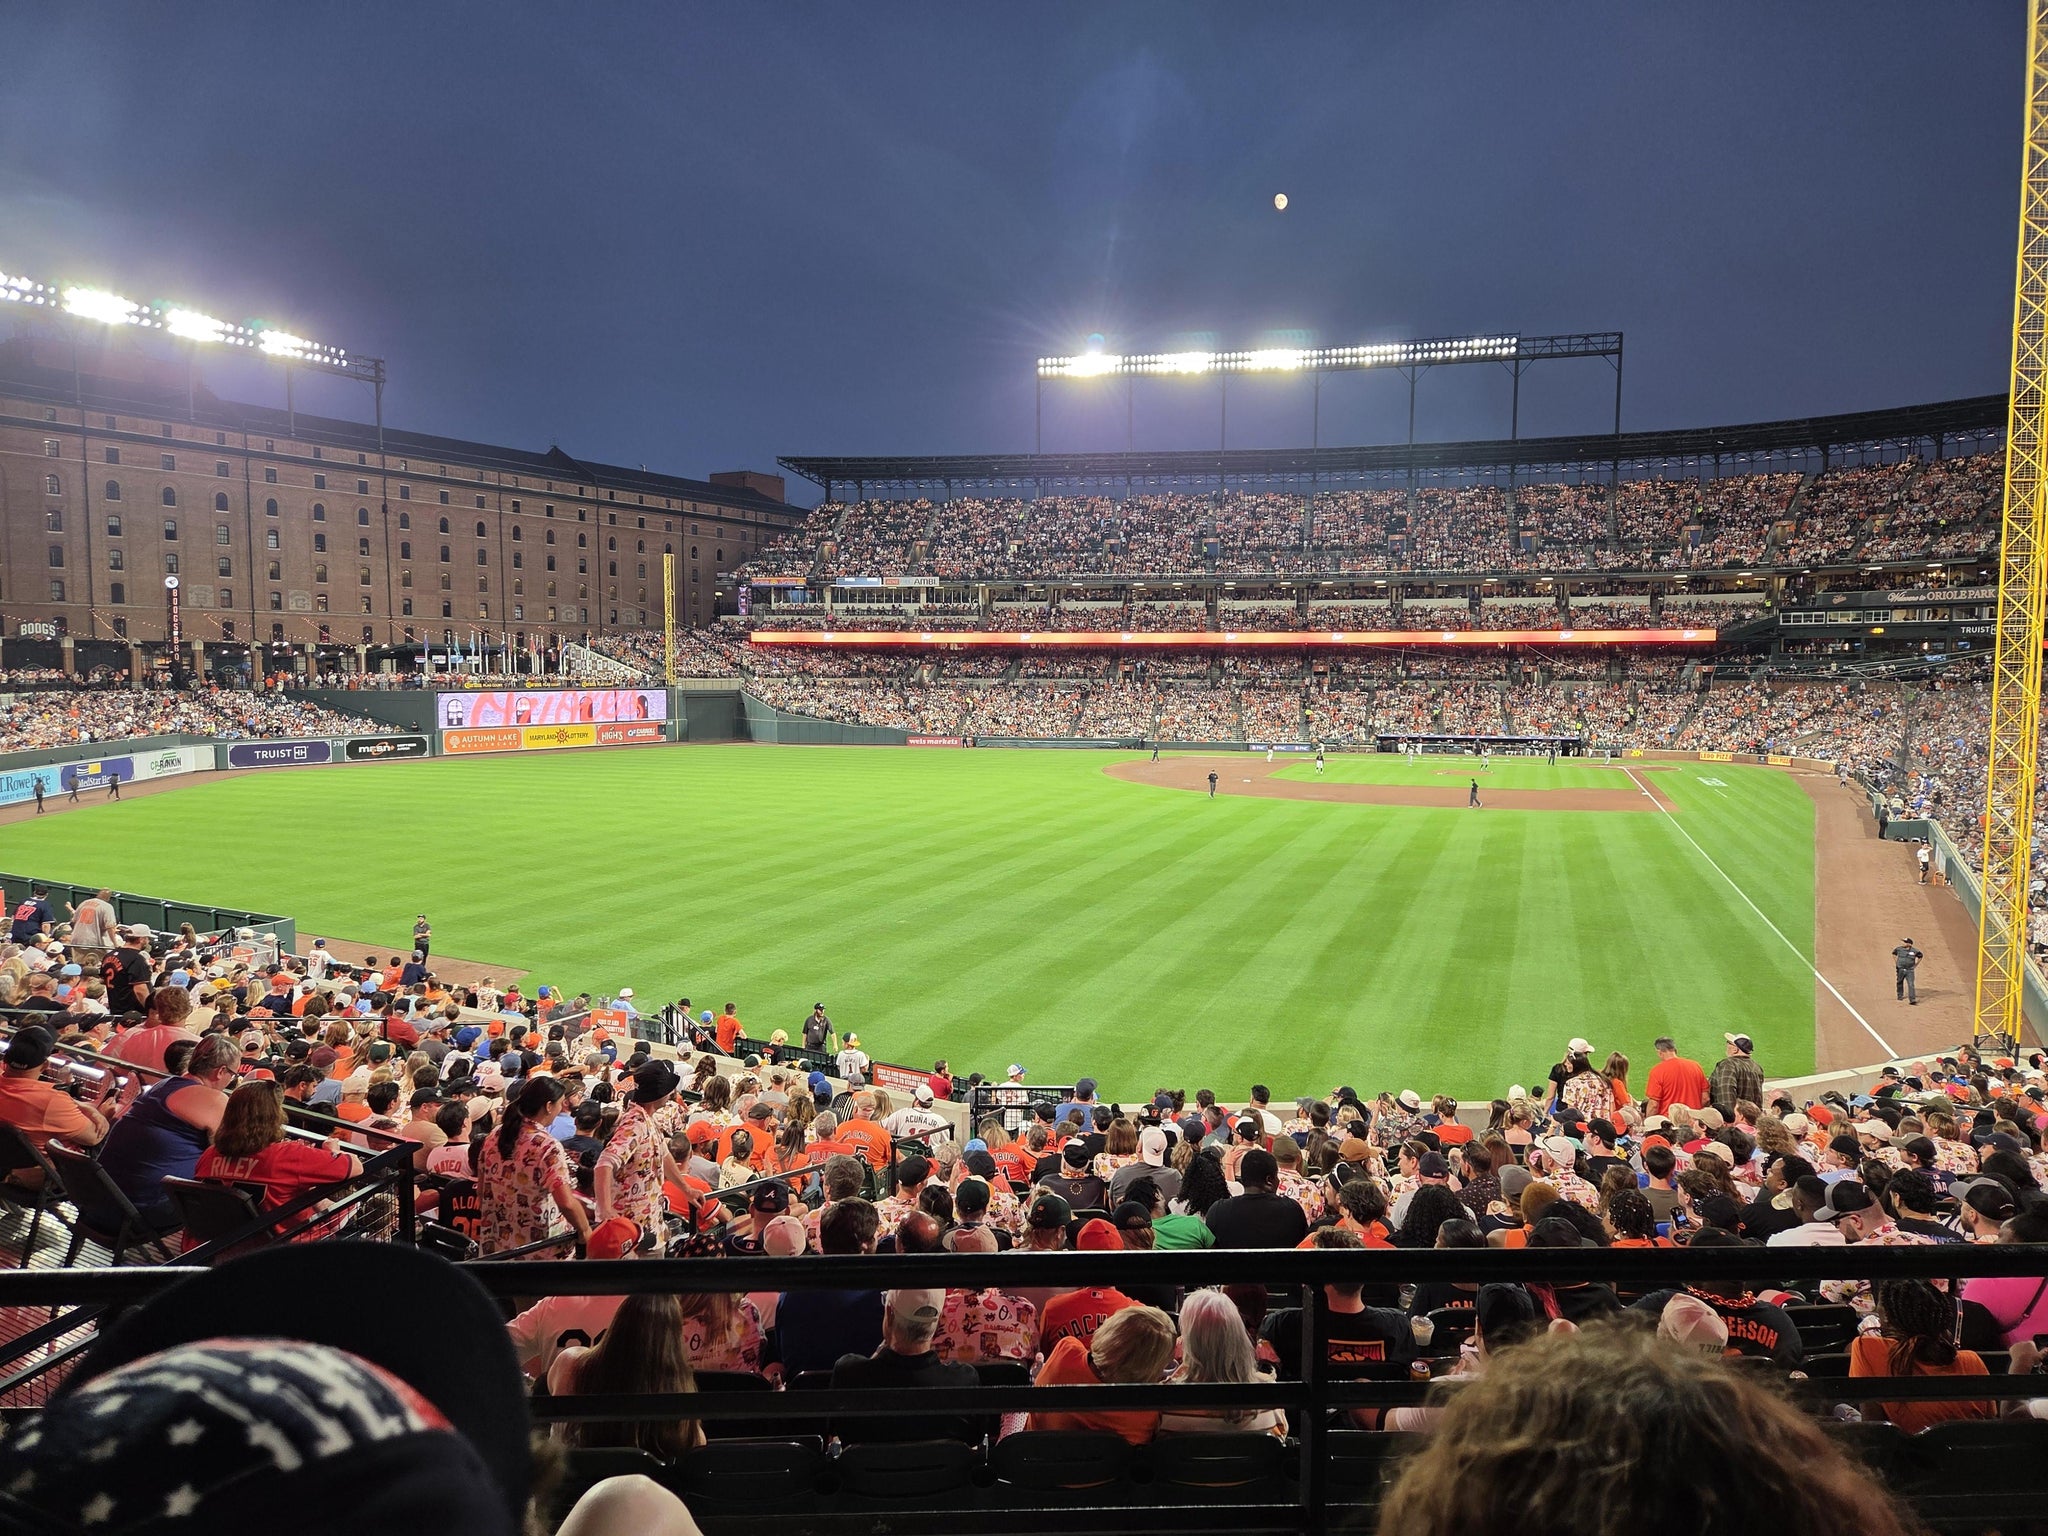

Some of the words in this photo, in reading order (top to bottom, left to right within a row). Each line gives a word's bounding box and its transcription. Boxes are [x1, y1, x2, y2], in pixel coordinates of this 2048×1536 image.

[1926, 590, 1967, 601] ORIOLE
[1968, 589, 1997, 599] PARK
[1961, 626, 1990, 634] TRUIST
[601, 731, 623, 741] HIGH'S
[254, 749, 292, 759] TRUIST
[31, 773, 51, 788] Pice
[15, 905, 37, 921] 27
[905, 1114, 928, 1125] ACUÑA
[211, 1156, 260, 1179] RILEY
[434, 1160, 462, 1173] MATEO
[452, 1195, 481, 1211] ALON
[1057, 1313, 1108, 1340] MACH
[1726, 1315, 1779, 1350] ERSON
